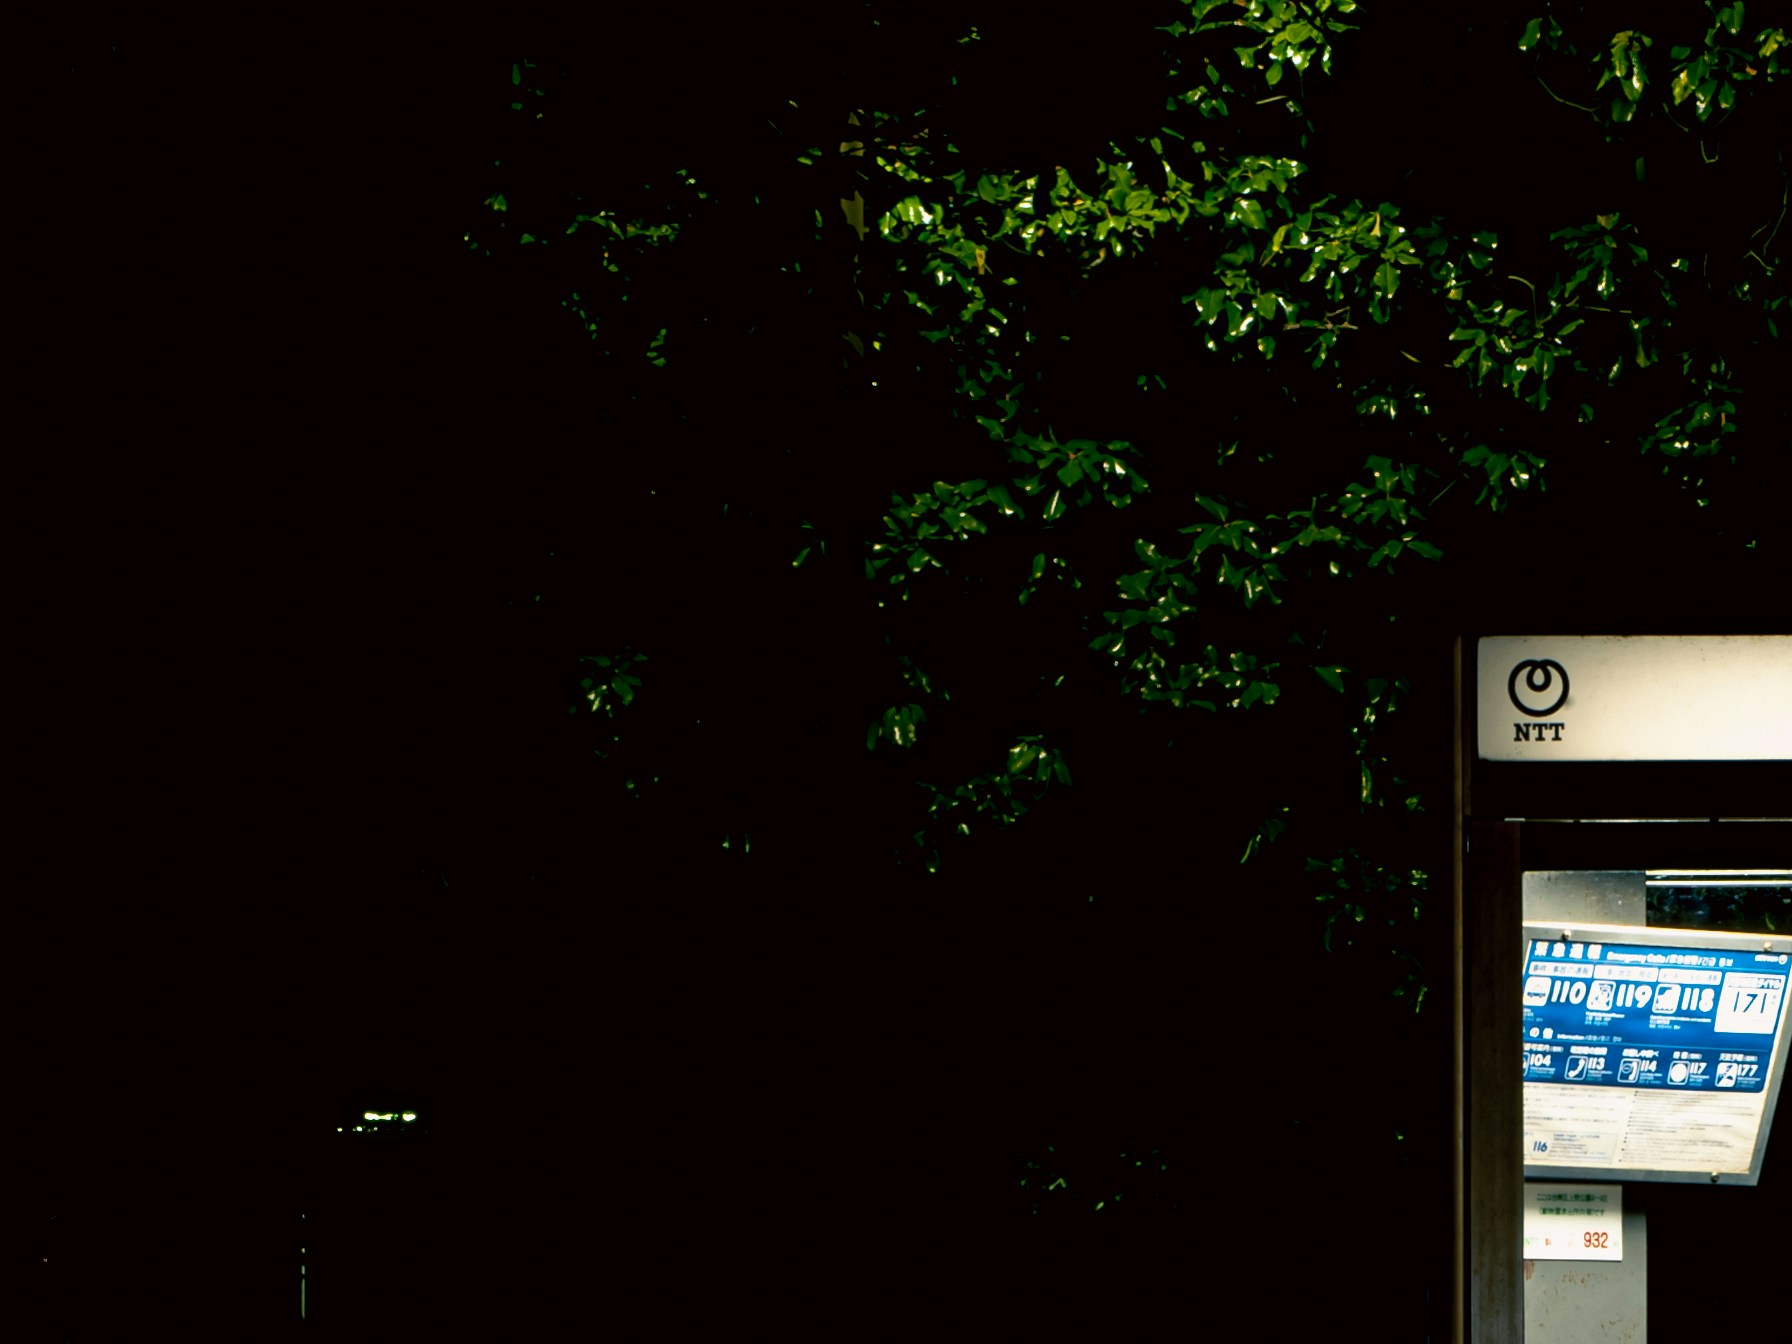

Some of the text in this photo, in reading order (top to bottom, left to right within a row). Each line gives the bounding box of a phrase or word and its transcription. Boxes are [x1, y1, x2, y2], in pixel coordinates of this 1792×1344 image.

[1513, 722, 1565, 742] NTT
[1551, 980, 1587, 1005] 110
[1616, 983, 1652, 1009] 119
[1681, 987, 1715, 1013] 118
[1733, 991, 1767, 1014] 171
[1529, 1053, 1552, 1067] 104
[1587, 1057, 1606, 1070] 113
[1640, 1060, 1658, 1073] 114
[1689, 1062, 1708, 1075] 117
[1737, 1064, 1759, 1077] 177
[1532, 1140, 1548, 1152] 116
[1583, 1231, 1609, 1249] 932
